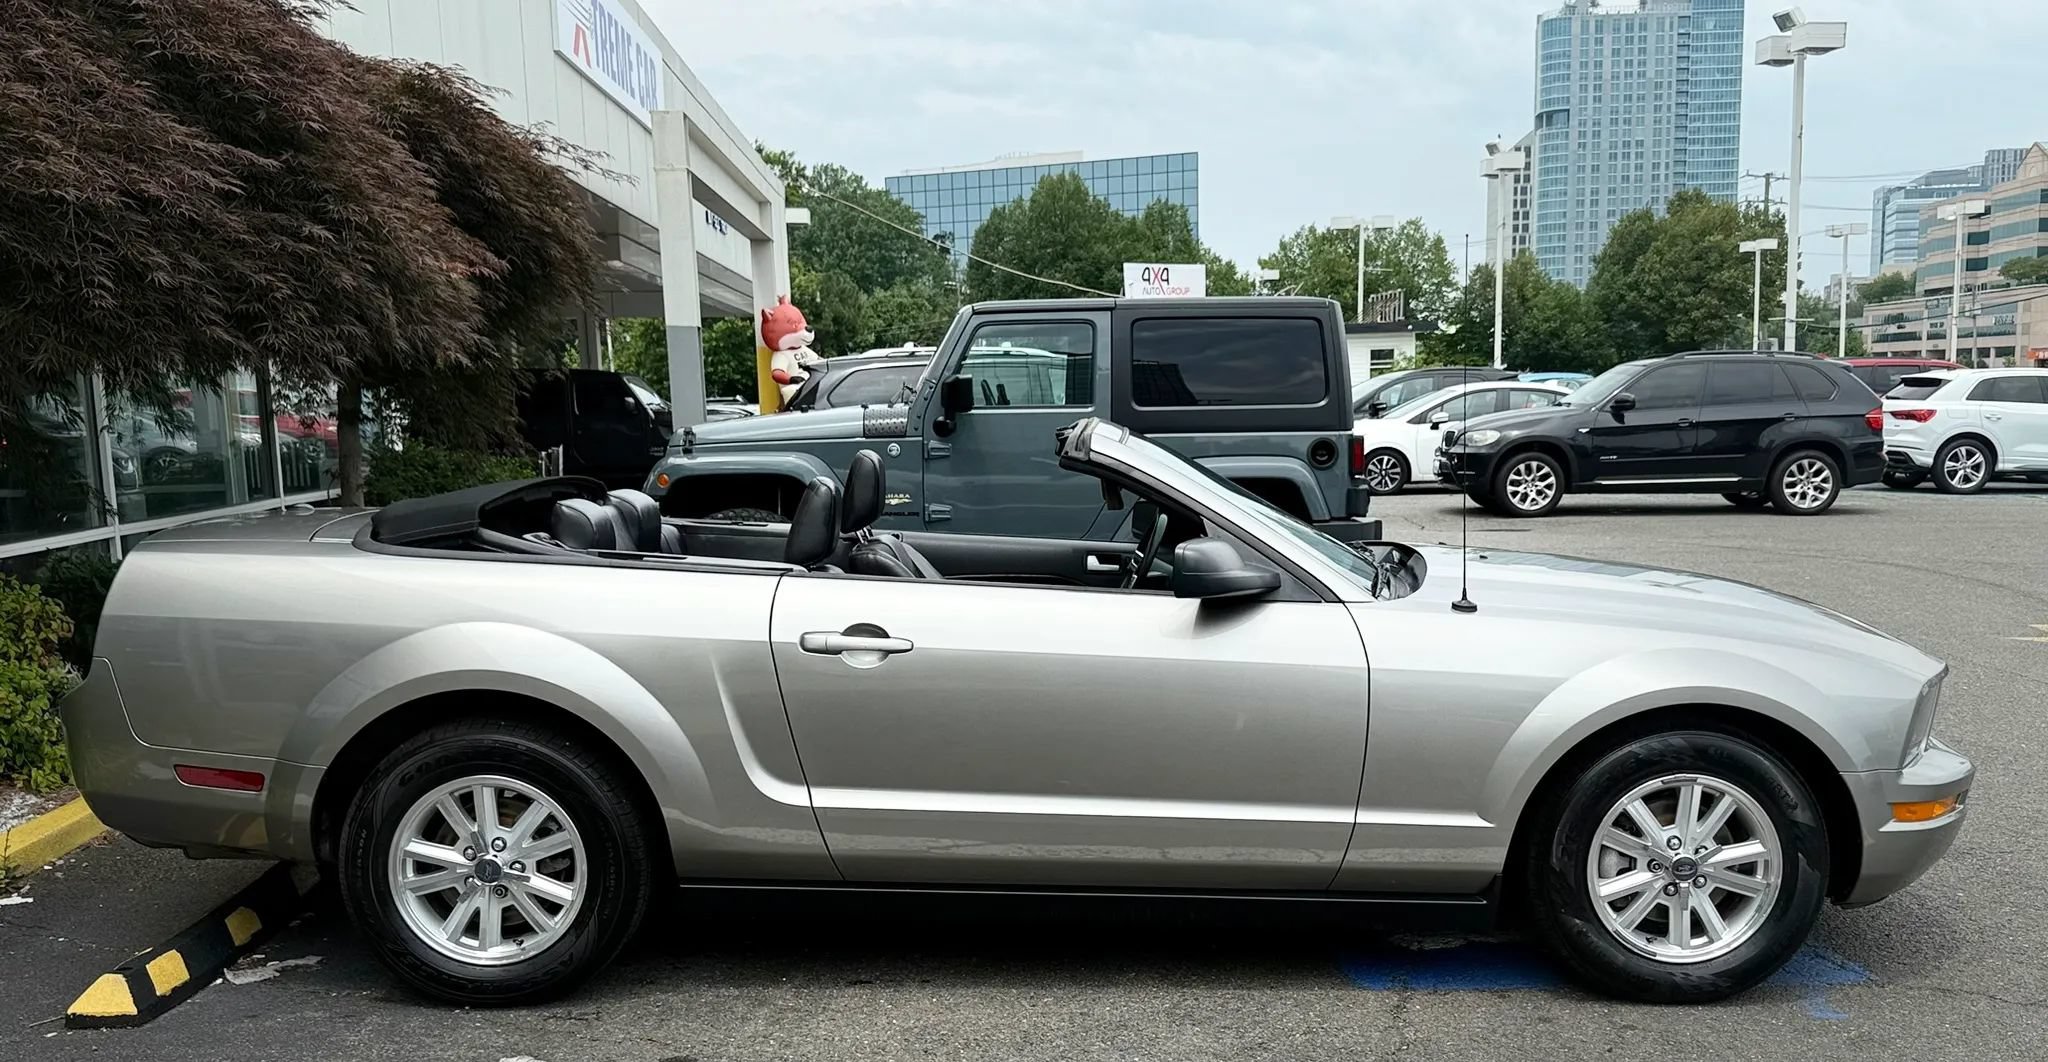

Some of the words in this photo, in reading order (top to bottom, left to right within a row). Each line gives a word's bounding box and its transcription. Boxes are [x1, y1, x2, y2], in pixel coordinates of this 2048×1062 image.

[636, 42, 658, 111] CAR
[1142, 286, 1161, 295] AUTO
[1165, 287, 1190, 295] GROUP
